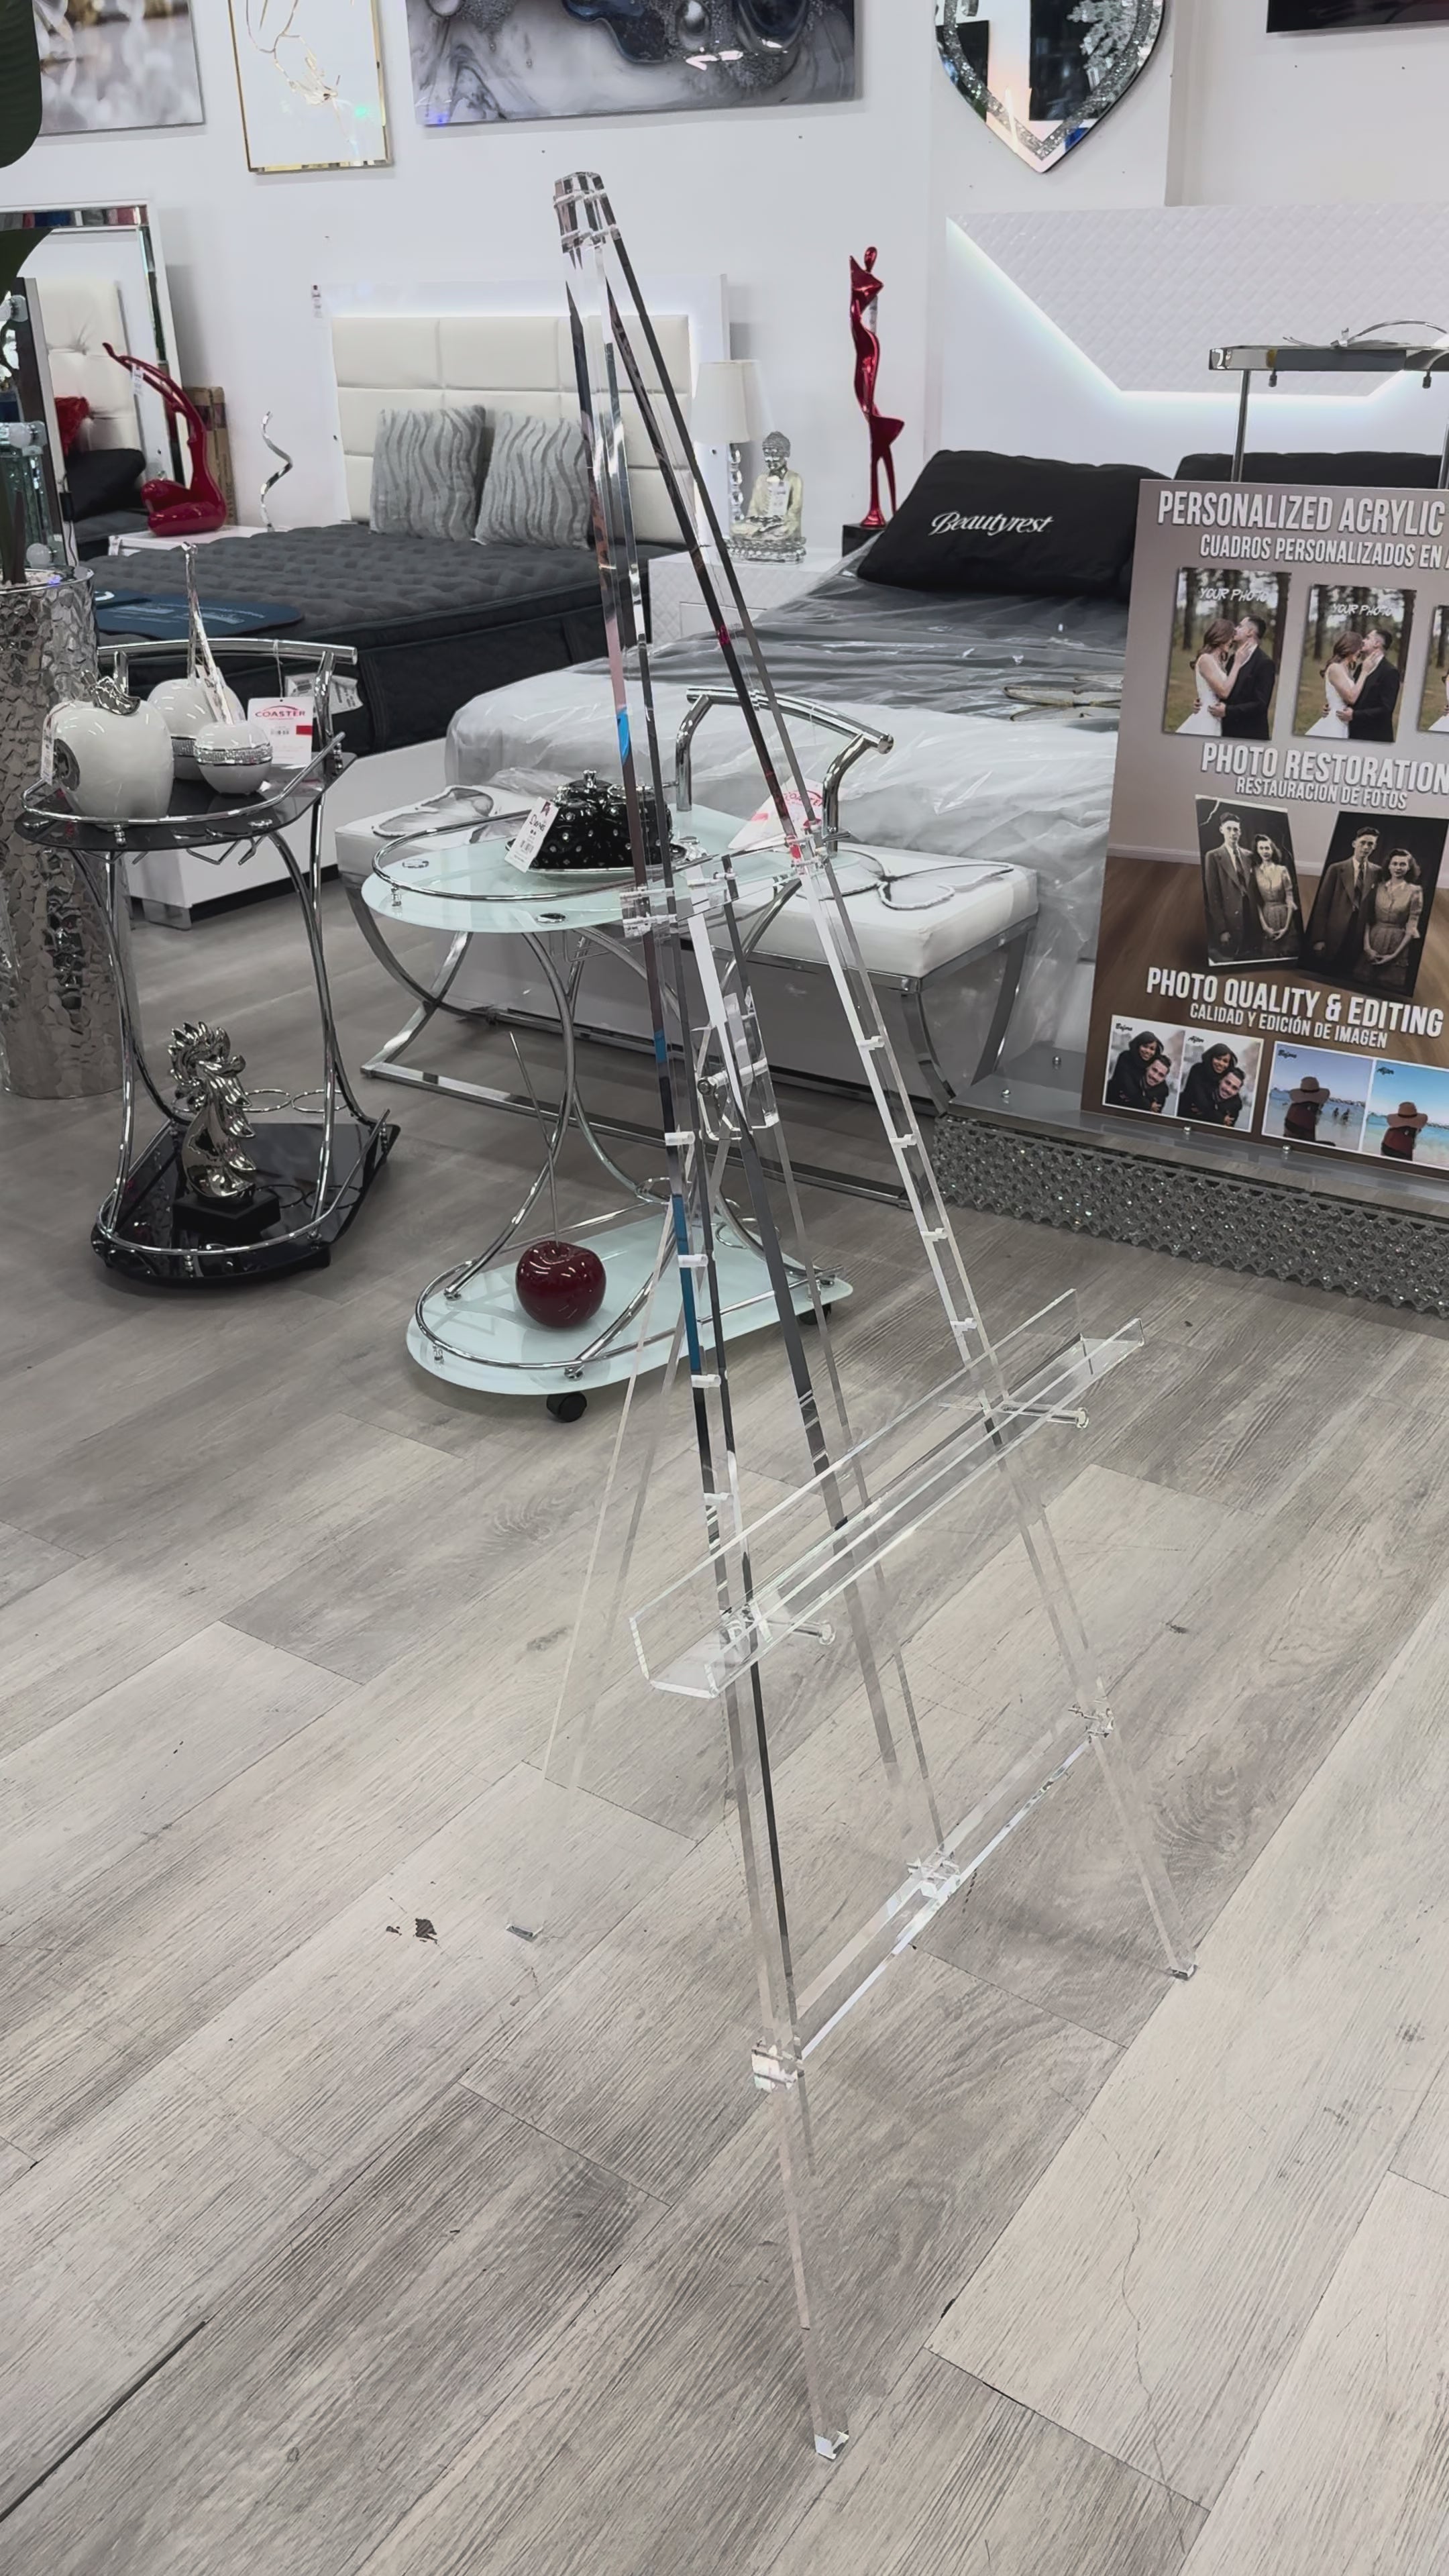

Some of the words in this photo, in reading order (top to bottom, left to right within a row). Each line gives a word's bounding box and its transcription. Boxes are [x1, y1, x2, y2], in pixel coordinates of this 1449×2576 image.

[928, 511, 1054, 536] Beautyrest
[1158, 490, 1333, 531] PERSONALIZED
[1338, 498, 1445, 537] ACRYLIC
[1199, 534, 1271, 560] CUADROS
[1275, 537, 1415, 568] PERSONALIZADOS
[1419, 544, 1442, 569] EN
[1199, 588, 1230, 600] YOUR
[1332, 604, 1358, 615] YOUR
[1201, 742, 1278, 777] PHOTO
[1283, 749, 1449, 795] RESTORATION
[1340, 786, 1361, 806] DE
[1362, 788, 1407, 810] FOTOS
[1146, 967, 1218, 1003] PHOTO
[1223, 978, 1320, 1019] QUALITY
[1325, 993, 1342, 1022] &
[1347, 996, 1444, 1038] EDITING
[1189, 1003, 1244, 1026] CALIDAD
[1247, 1011, 1256, 1027] Y
[1258, 1012, 1311, 1036] EDICIÓN
[1313, 1022, 1332, 1039] DE
[1334, 1024, 1389, 1049] IMAGEN
